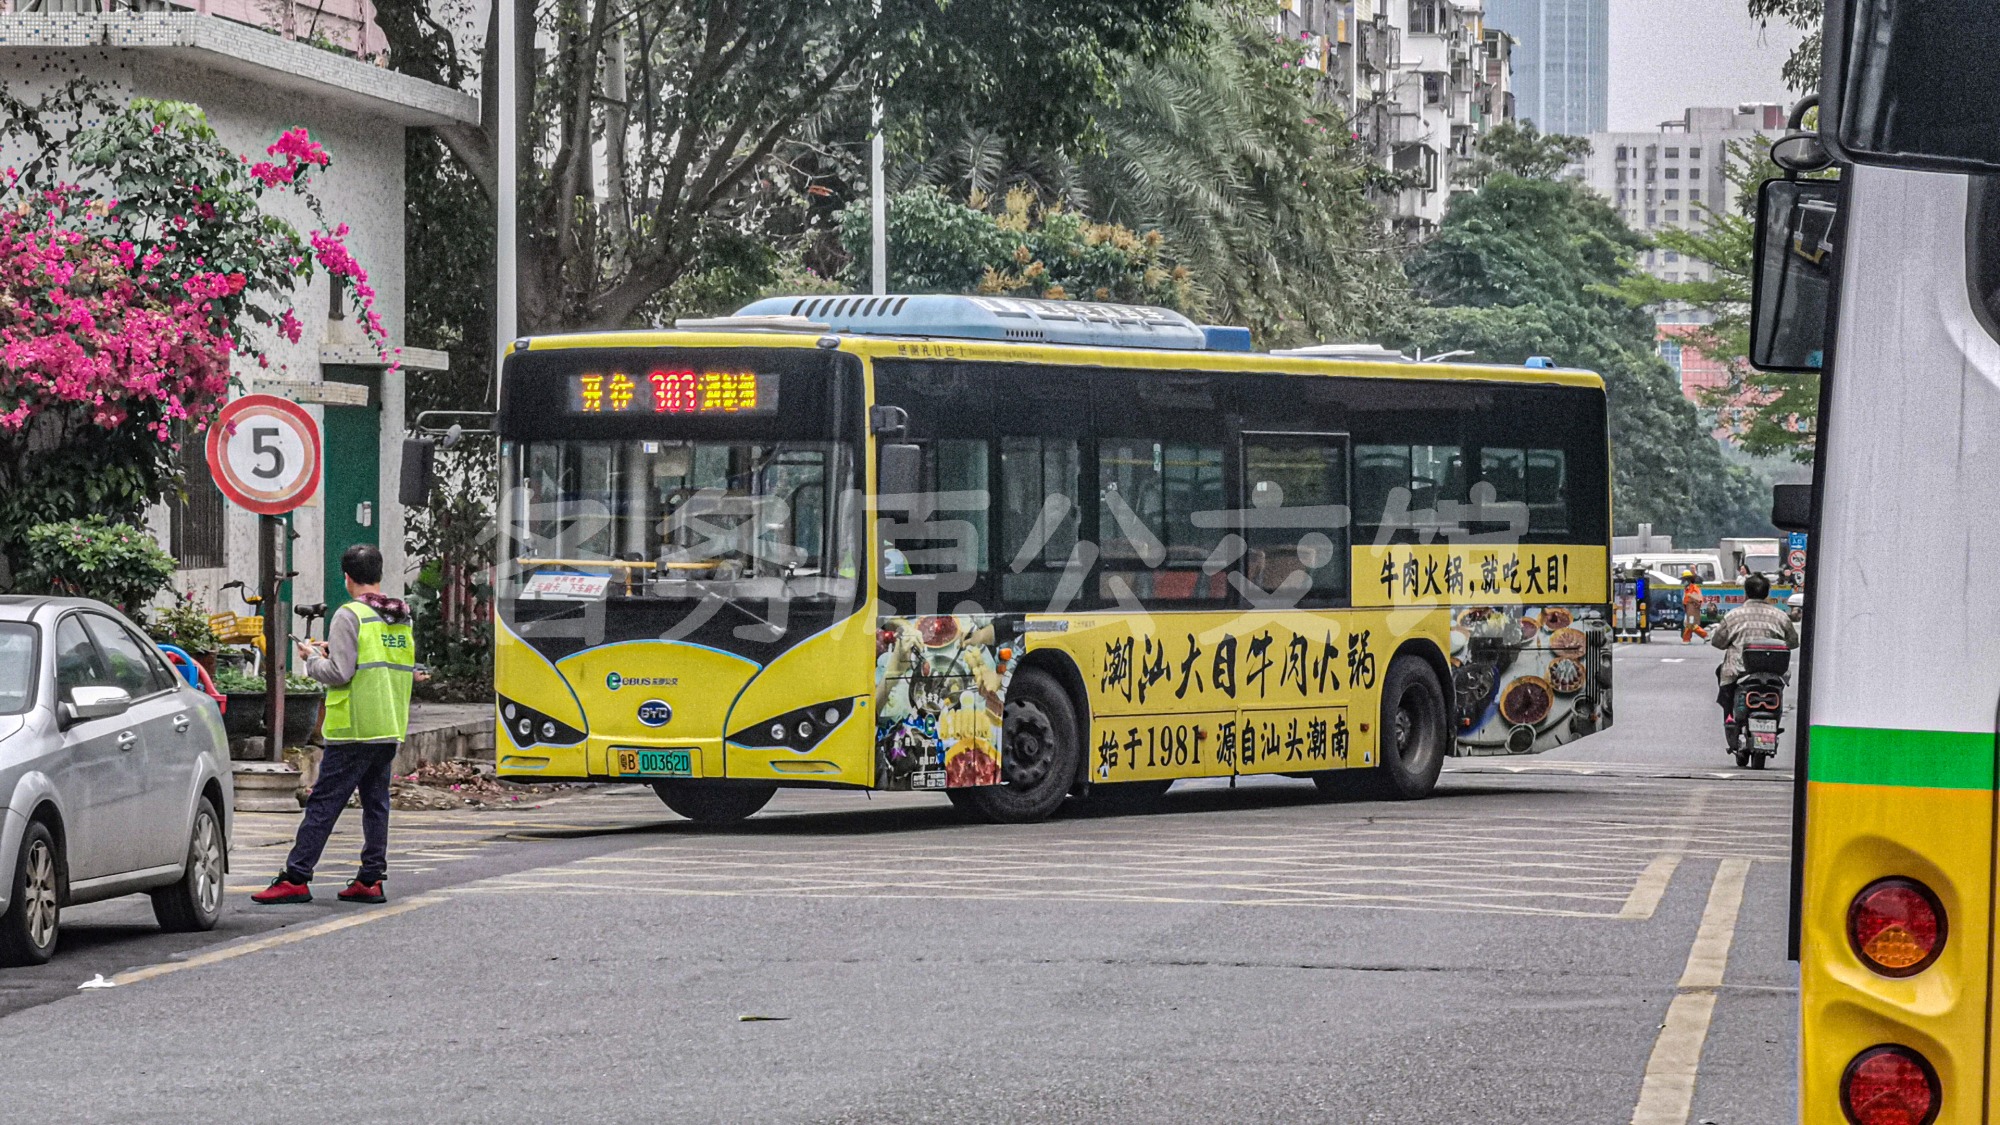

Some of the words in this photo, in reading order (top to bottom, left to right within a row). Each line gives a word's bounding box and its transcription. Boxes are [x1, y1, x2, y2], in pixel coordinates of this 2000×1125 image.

[649, 371, 696, 412] 303
[251, 427, 285, 479] 5
[1380, 551, 1569, 600] 牛肉火锅，就吃大目！
[1101, 629, 1376, 705] 潮汕大目牛肉火锅
[640, 707, 668, 719] BYD
[1097, 725, 1201, 774] 始于1981
[1216, 714, 1350, 765] 源自汕头潮南
